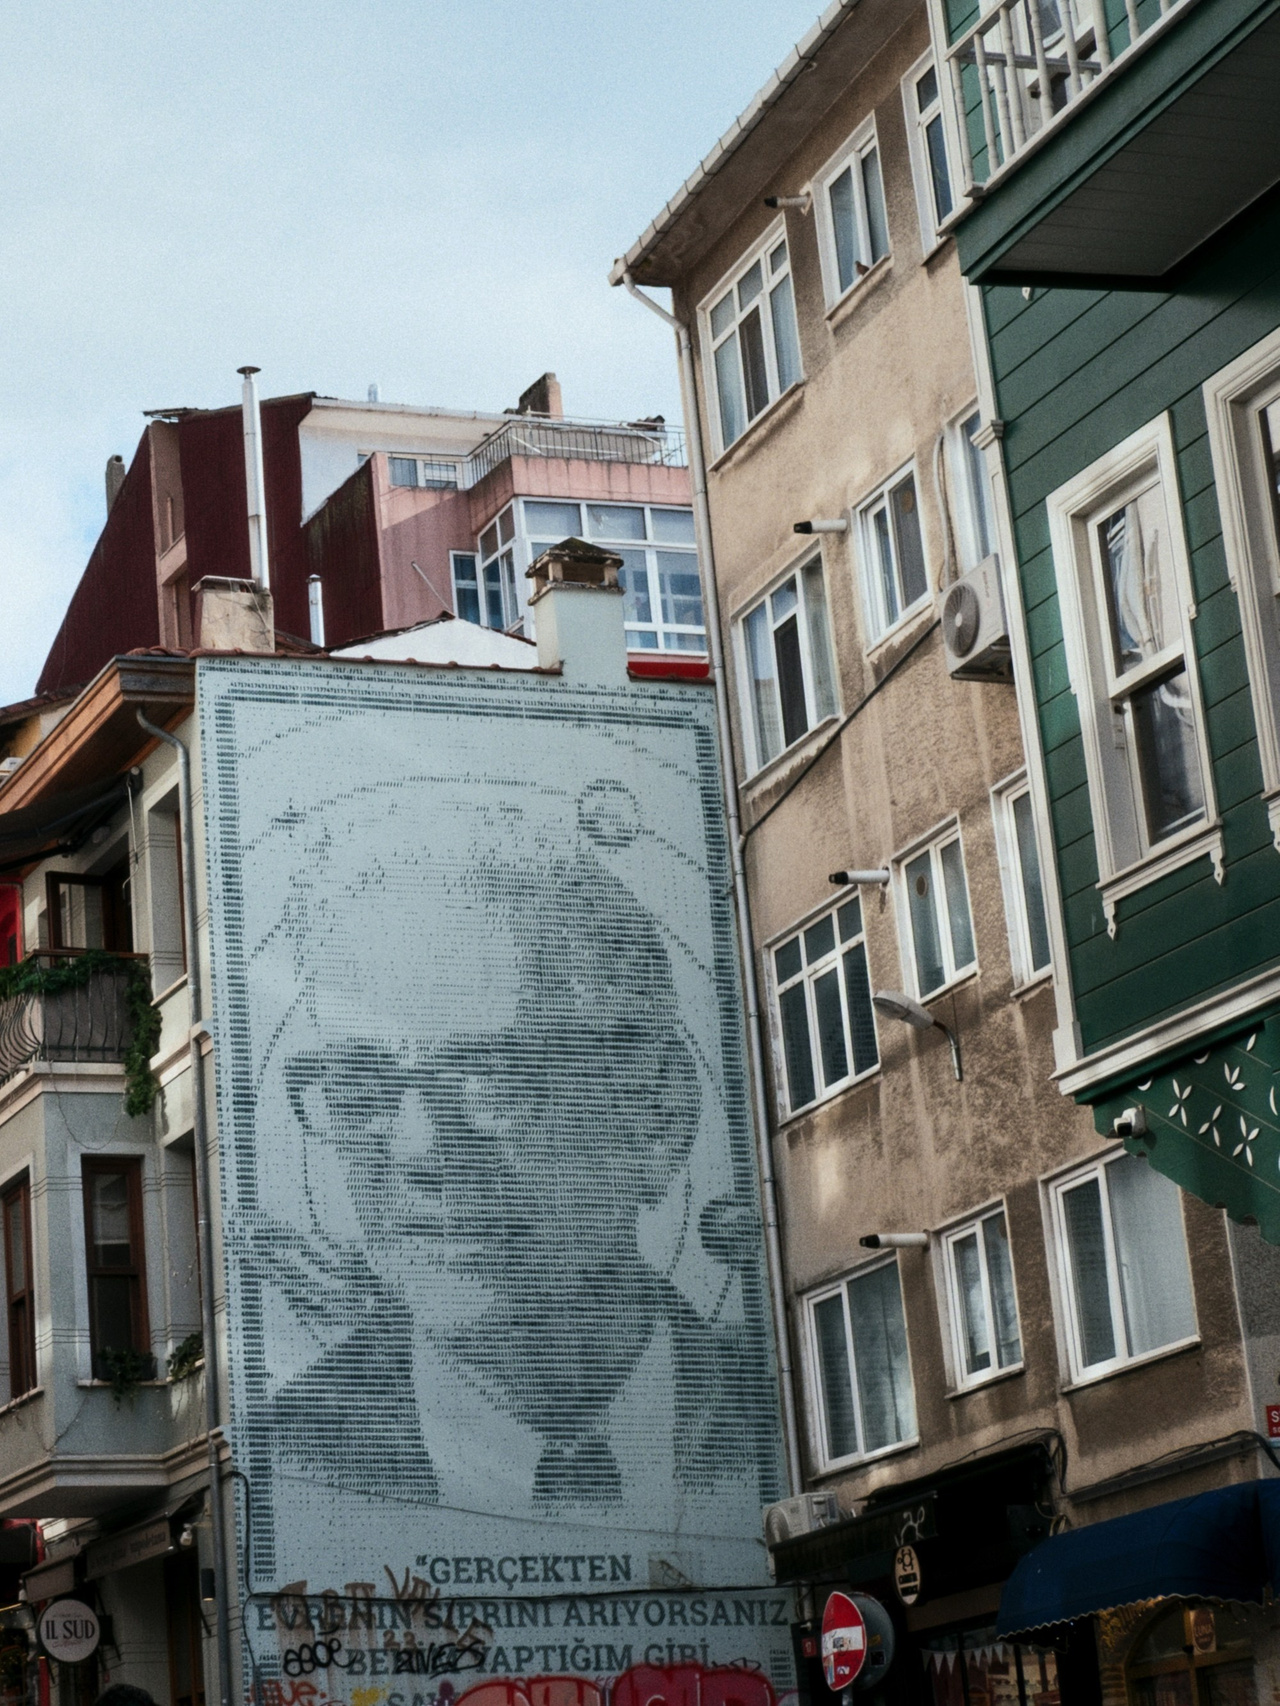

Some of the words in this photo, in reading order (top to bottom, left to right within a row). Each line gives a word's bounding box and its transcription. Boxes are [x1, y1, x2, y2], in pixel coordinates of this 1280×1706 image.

[563, 1598, 788, 1627] ARIYORSANIZ
[45, 1619, 58, 1640] IL
[62, 1619, 96, 1640] SUD
